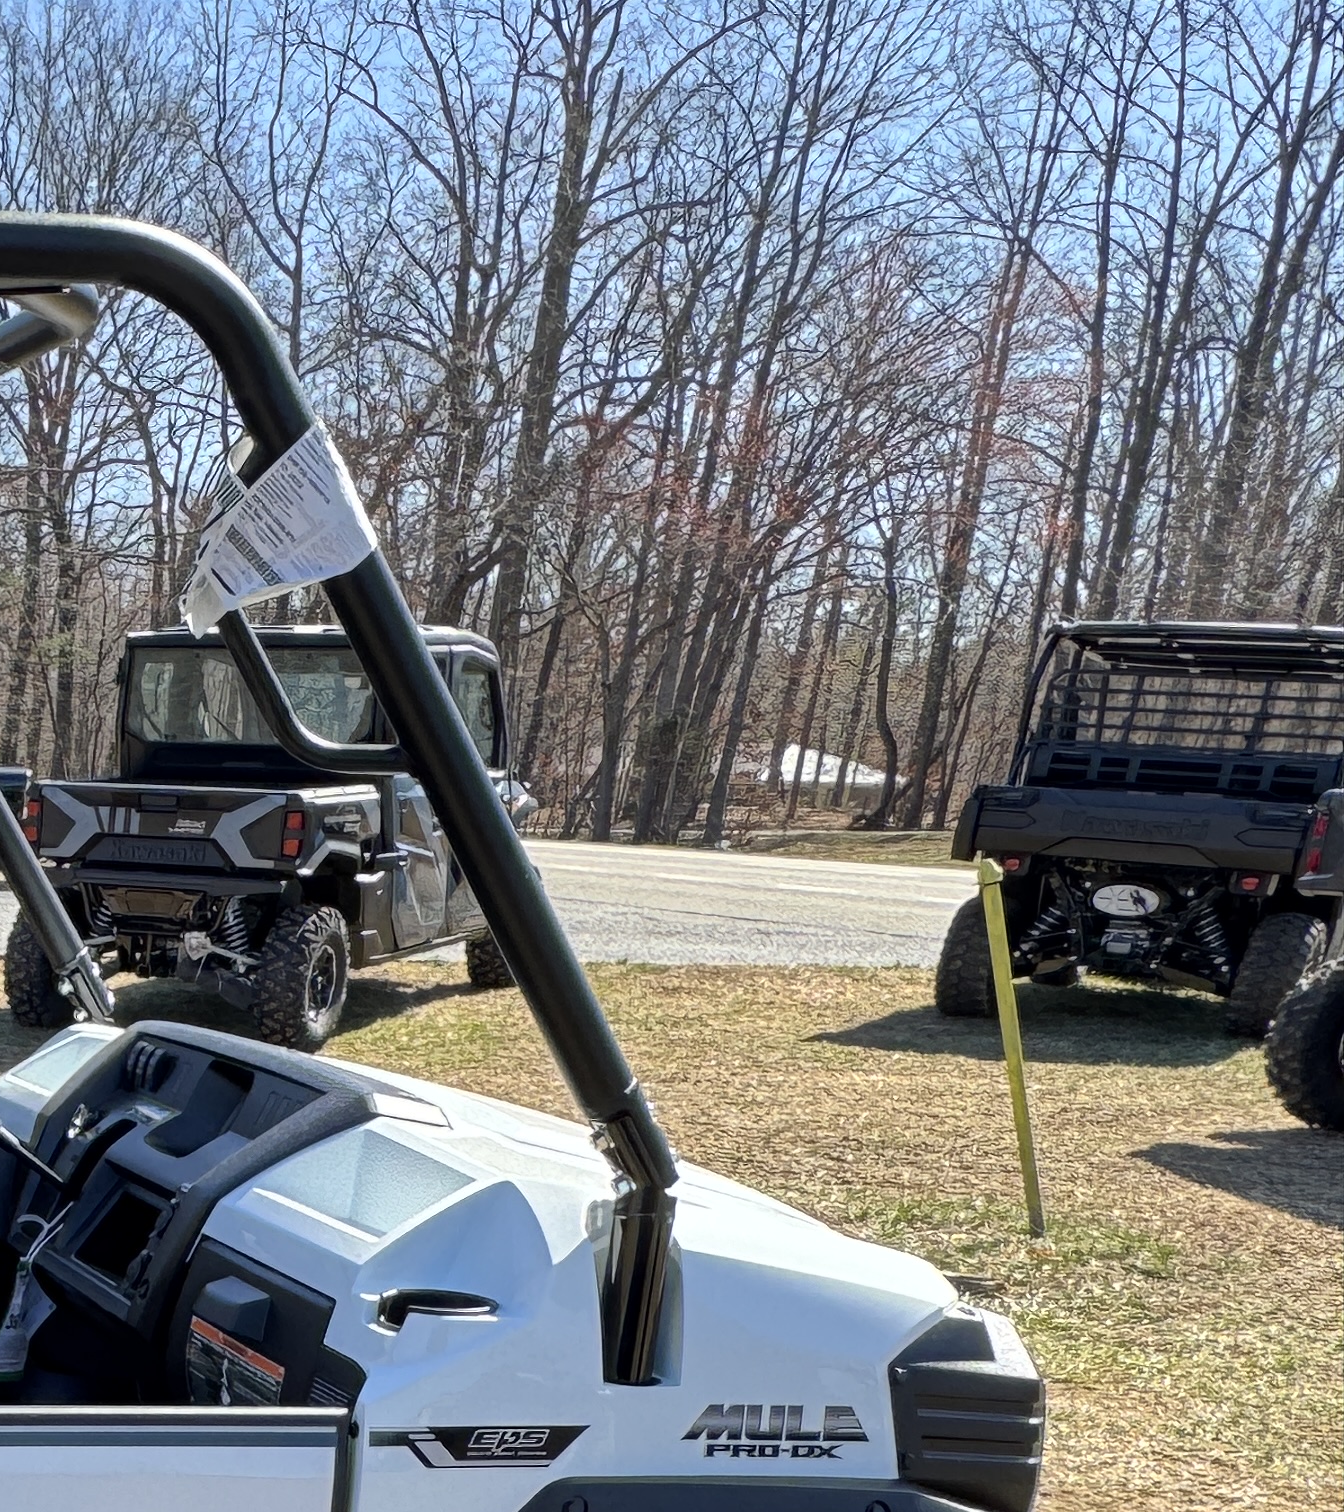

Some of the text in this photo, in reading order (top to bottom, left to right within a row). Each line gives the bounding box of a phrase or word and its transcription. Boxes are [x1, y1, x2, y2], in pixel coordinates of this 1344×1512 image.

[680, 1404, 869, 1442] MULE
[467, 1429, 550, 1452] EPS
[703, 1444, 845, 1460] PRO-DX
